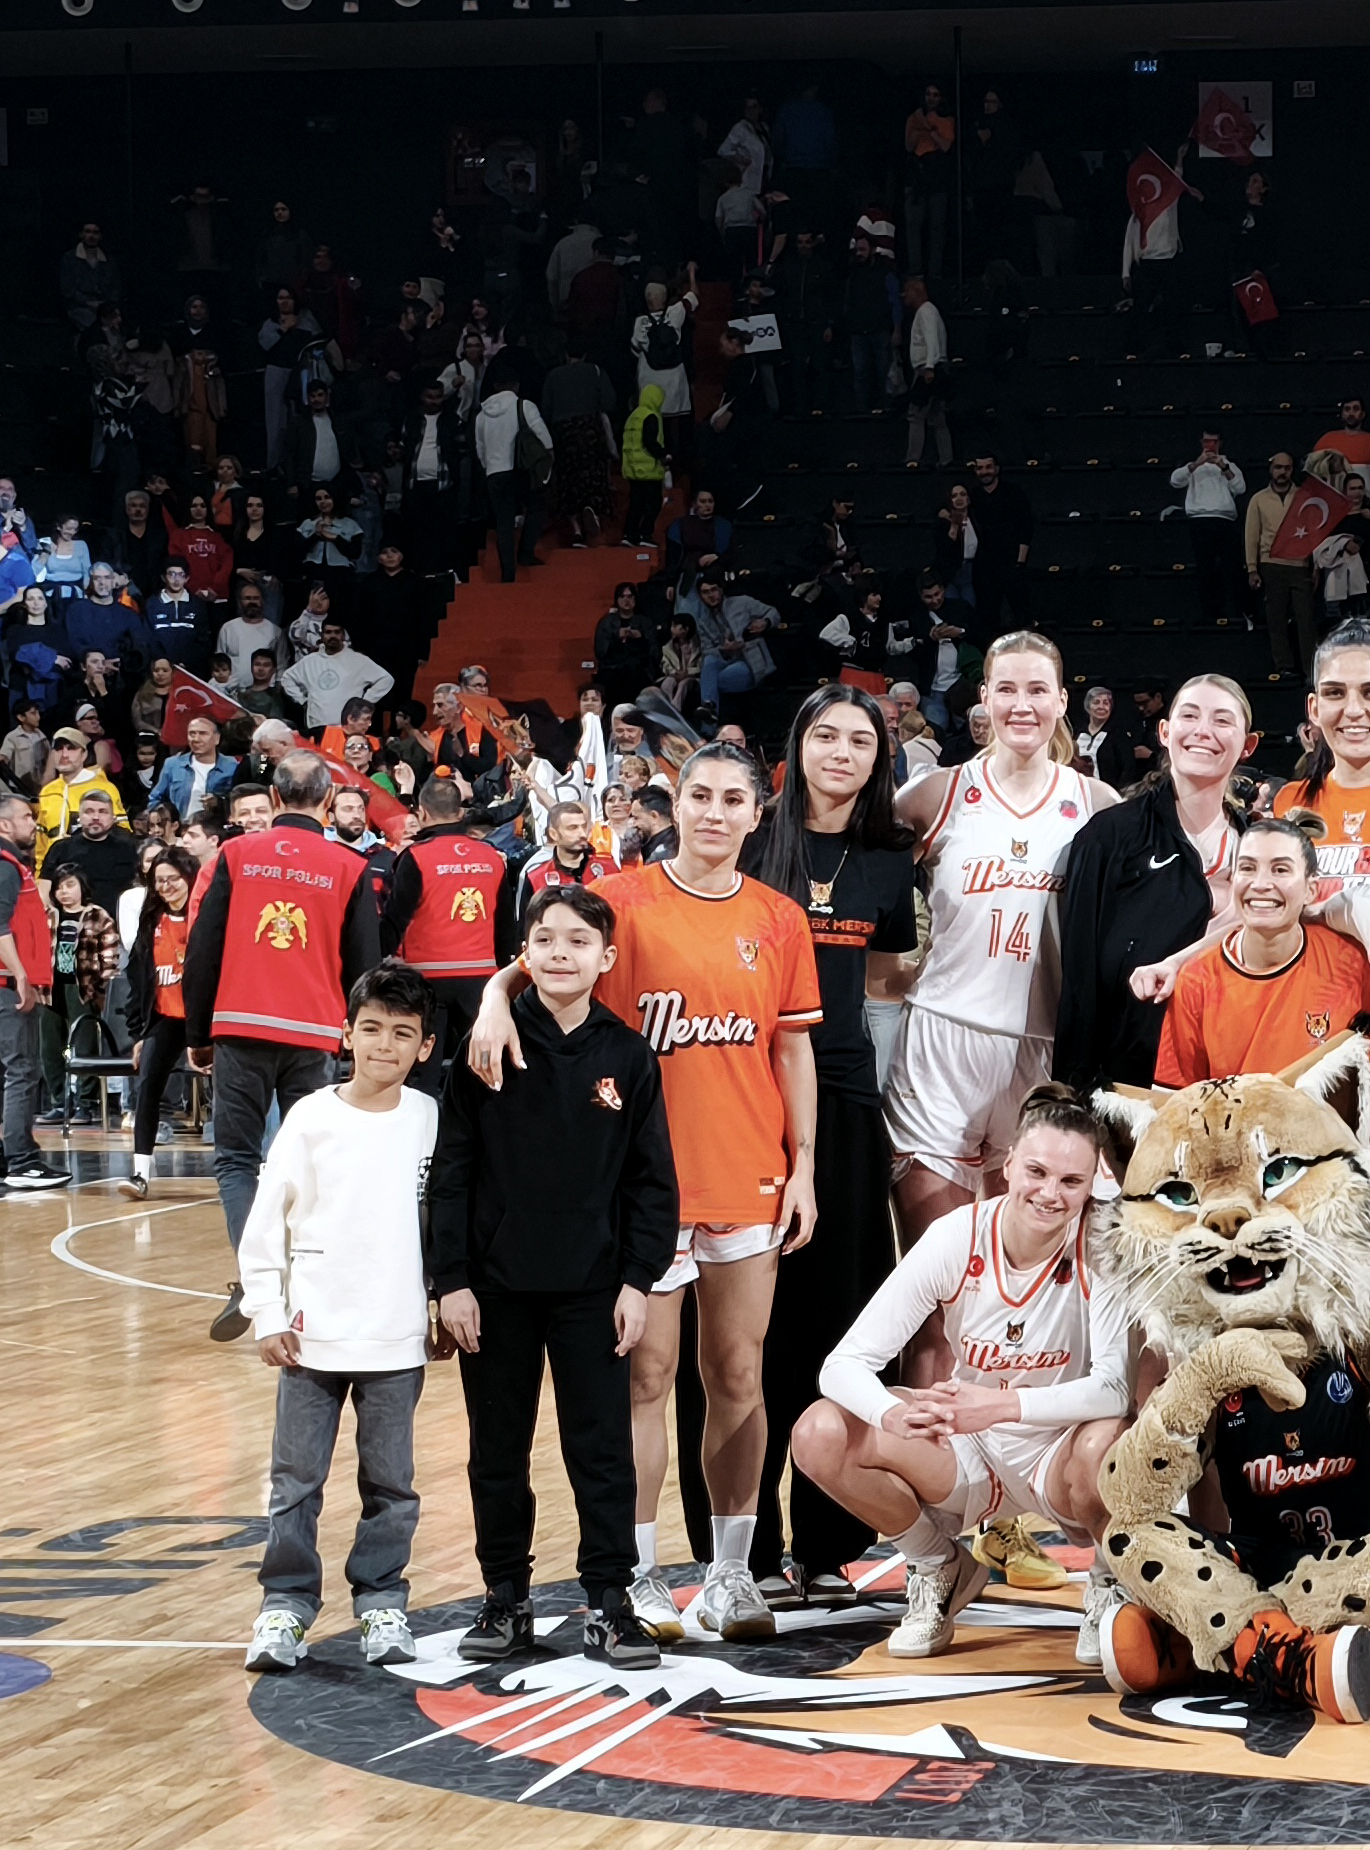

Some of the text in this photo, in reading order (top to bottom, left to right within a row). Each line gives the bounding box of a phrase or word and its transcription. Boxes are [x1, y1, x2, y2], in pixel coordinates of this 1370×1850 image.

[243, 863, 282, 879] SPOR
[962, 856, 1067, 895] Mersin
[988, 908, 1032, 962] 14
[637, 989, 758, 1055] Mersin
[960, 1335, 1071, 1372] Mersin
[1242, 1455, 1356, 1496] Mersin
